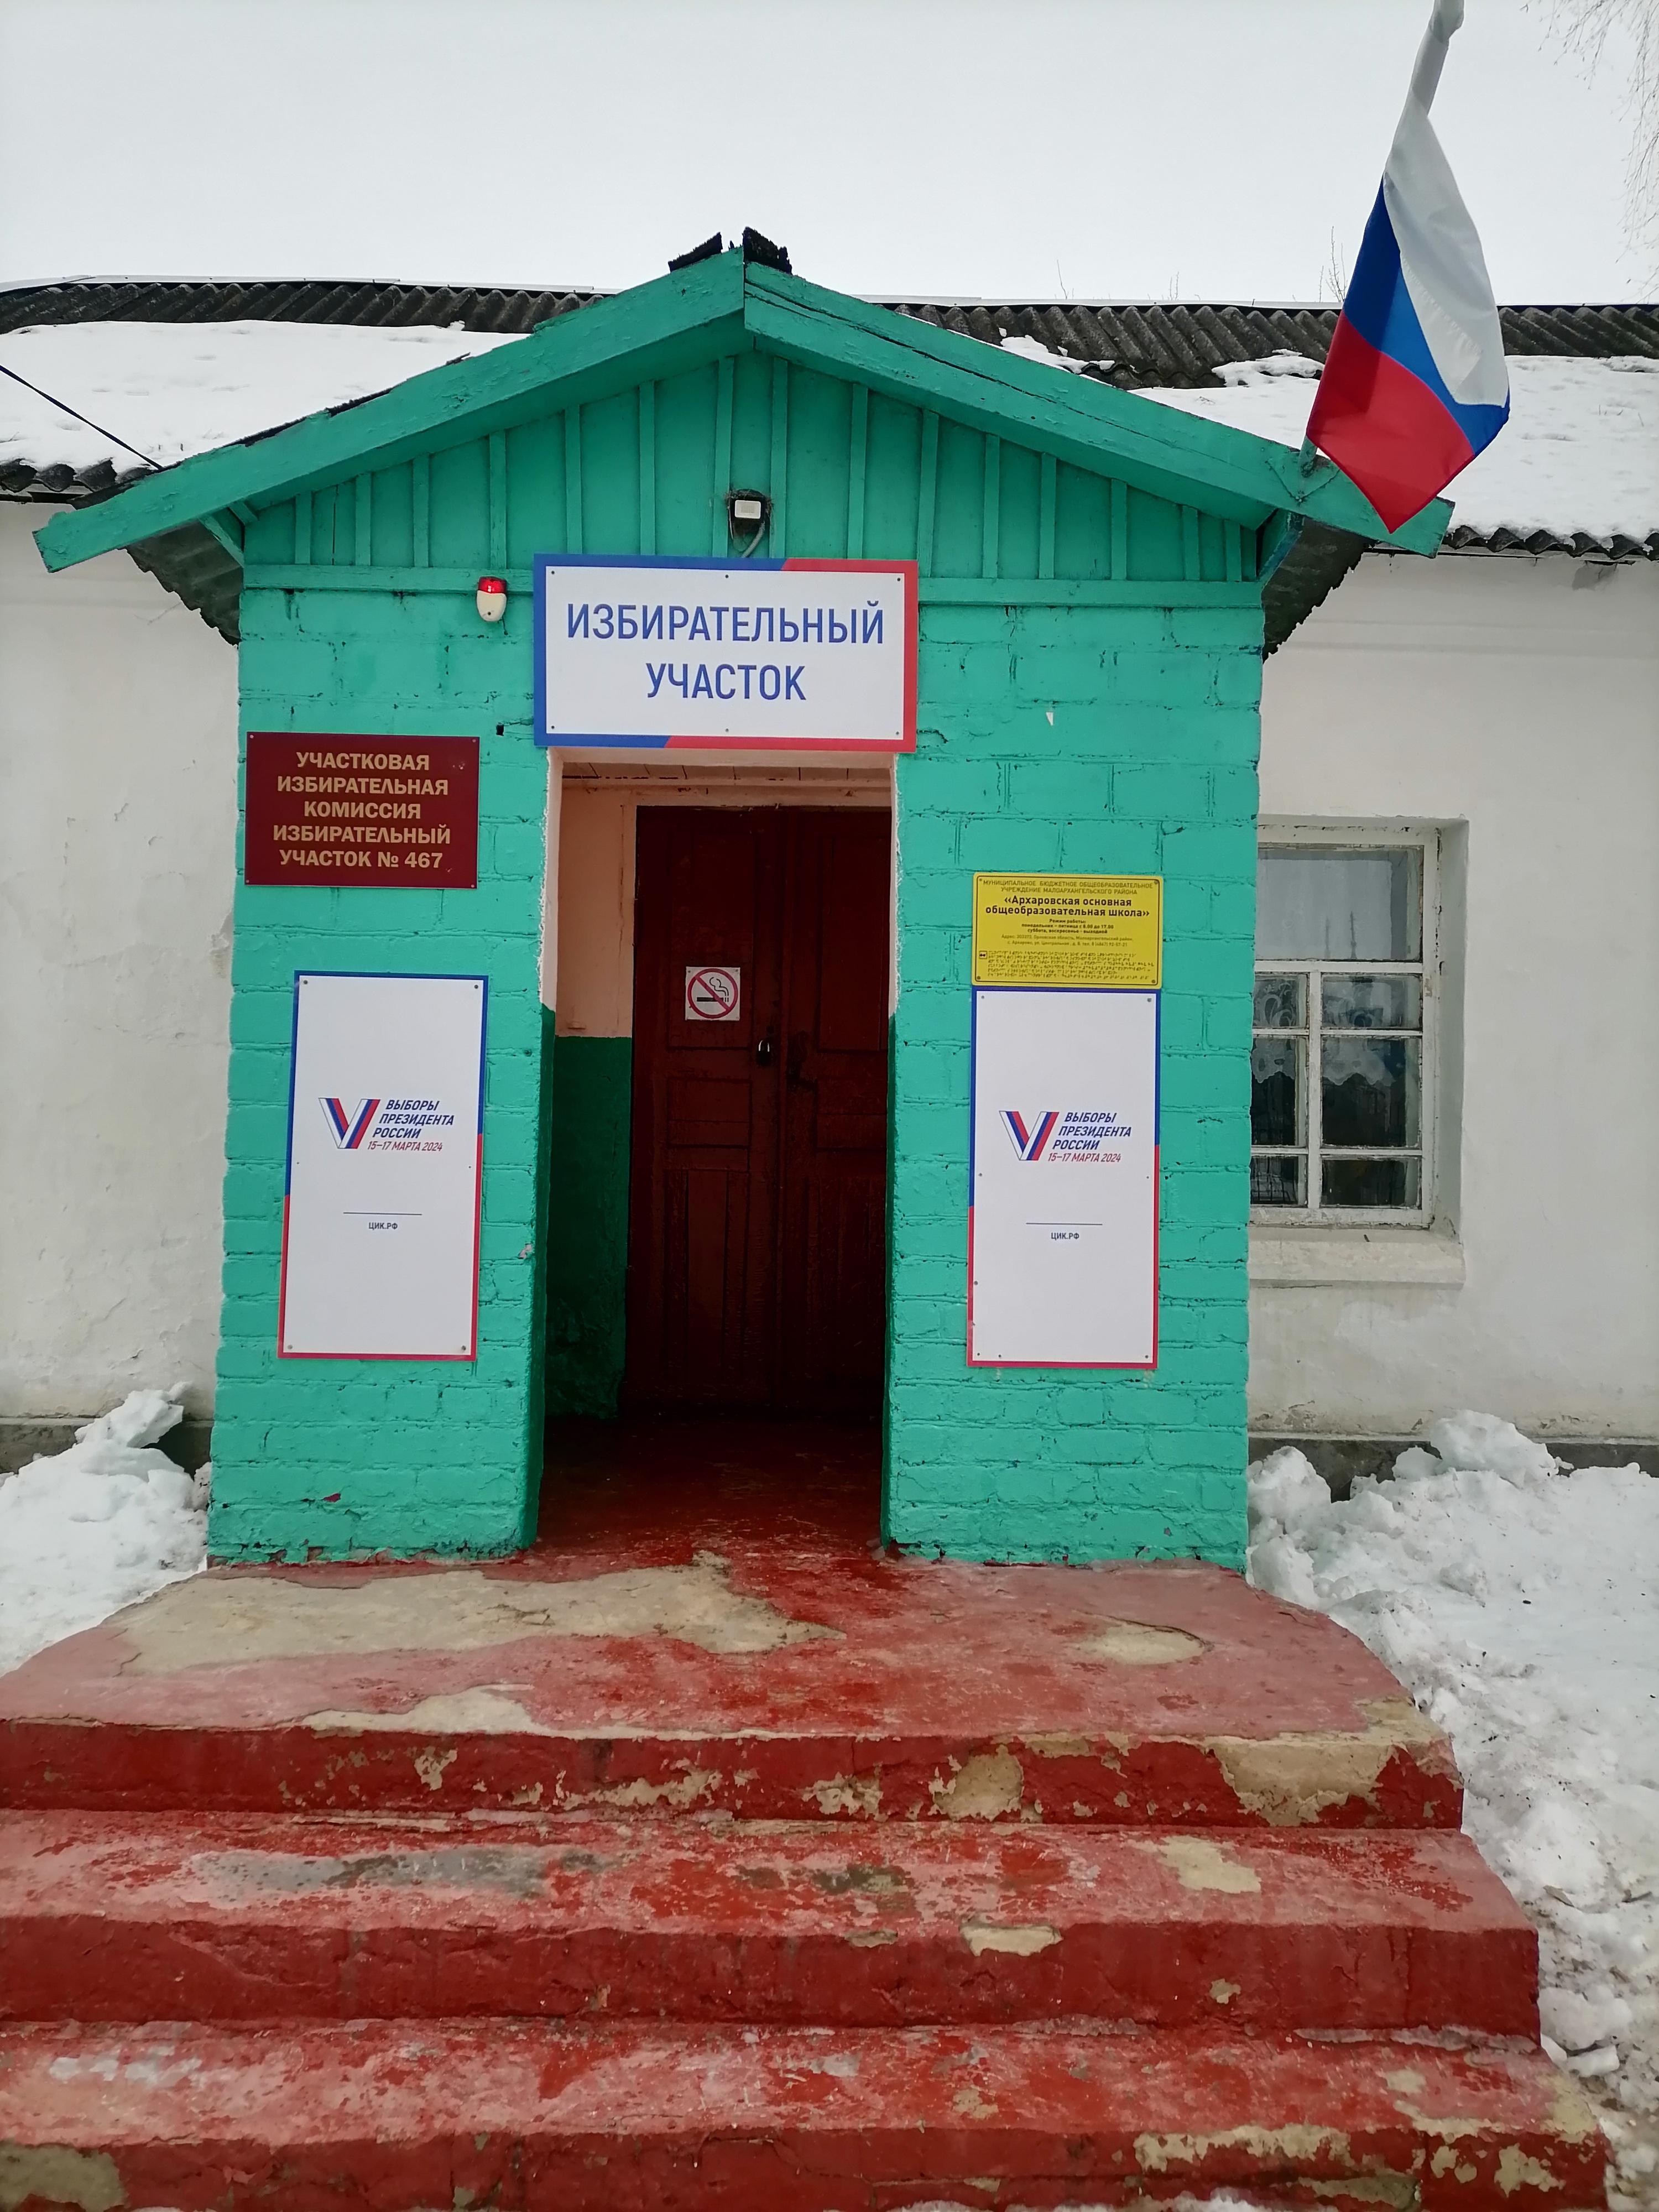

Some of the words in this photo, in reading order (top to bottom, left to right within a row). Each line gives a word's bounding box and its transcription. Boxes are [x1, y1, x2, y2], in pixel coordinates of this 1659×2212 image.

[567, 600, 883, 644] ИЗБИРАТЕЛЬНЫЙ
[645, 663, 806, 701] УЧАСТОК
[296, 752, 430, 770] УЧАСТКОВАЯ
[277, 776, 448, 795] ИЗБИРАТЕЛЬНАЯ
[304, 801, 421, 819] КОМИССИЯ
[273, 824, 451, 844] ИЗБИРАТЕЛЬНЫЙ
[279, 849, 372, 867] УЧАСТОК
[378, 851, 399, 868] №
[404, 852, 443, 868] 467
[1004, 895, 1080, 906] «Архаровская
[1083, 898, 1132, 906] основная
[985, 905, 1105, 916] общеобразовательная
[385, 1099, 440, 1111] ВЫБОРЫ
[379, 1113, 454, 1126] ПРЕЗИДЕНТА
[1064, 1112, 1117, 1123] ВЫБОРЫ
[372, 1128, 421, 1139] РОССИИ
[1058, 1126, 1131, 1138] ПРЕЗИДЕНТА
[392, 1141, 421, 1151] МАРТА
[421, 1142, 443, 1151] 2024
[1052, 1140, 1100, 1150] РОССИИ
[1071, 1154, 1100, 1162] МАРТА
[1100, 1154, 1121, 1162] 2024
[368, 1222, 398, 1230] ЦИК.РФ
